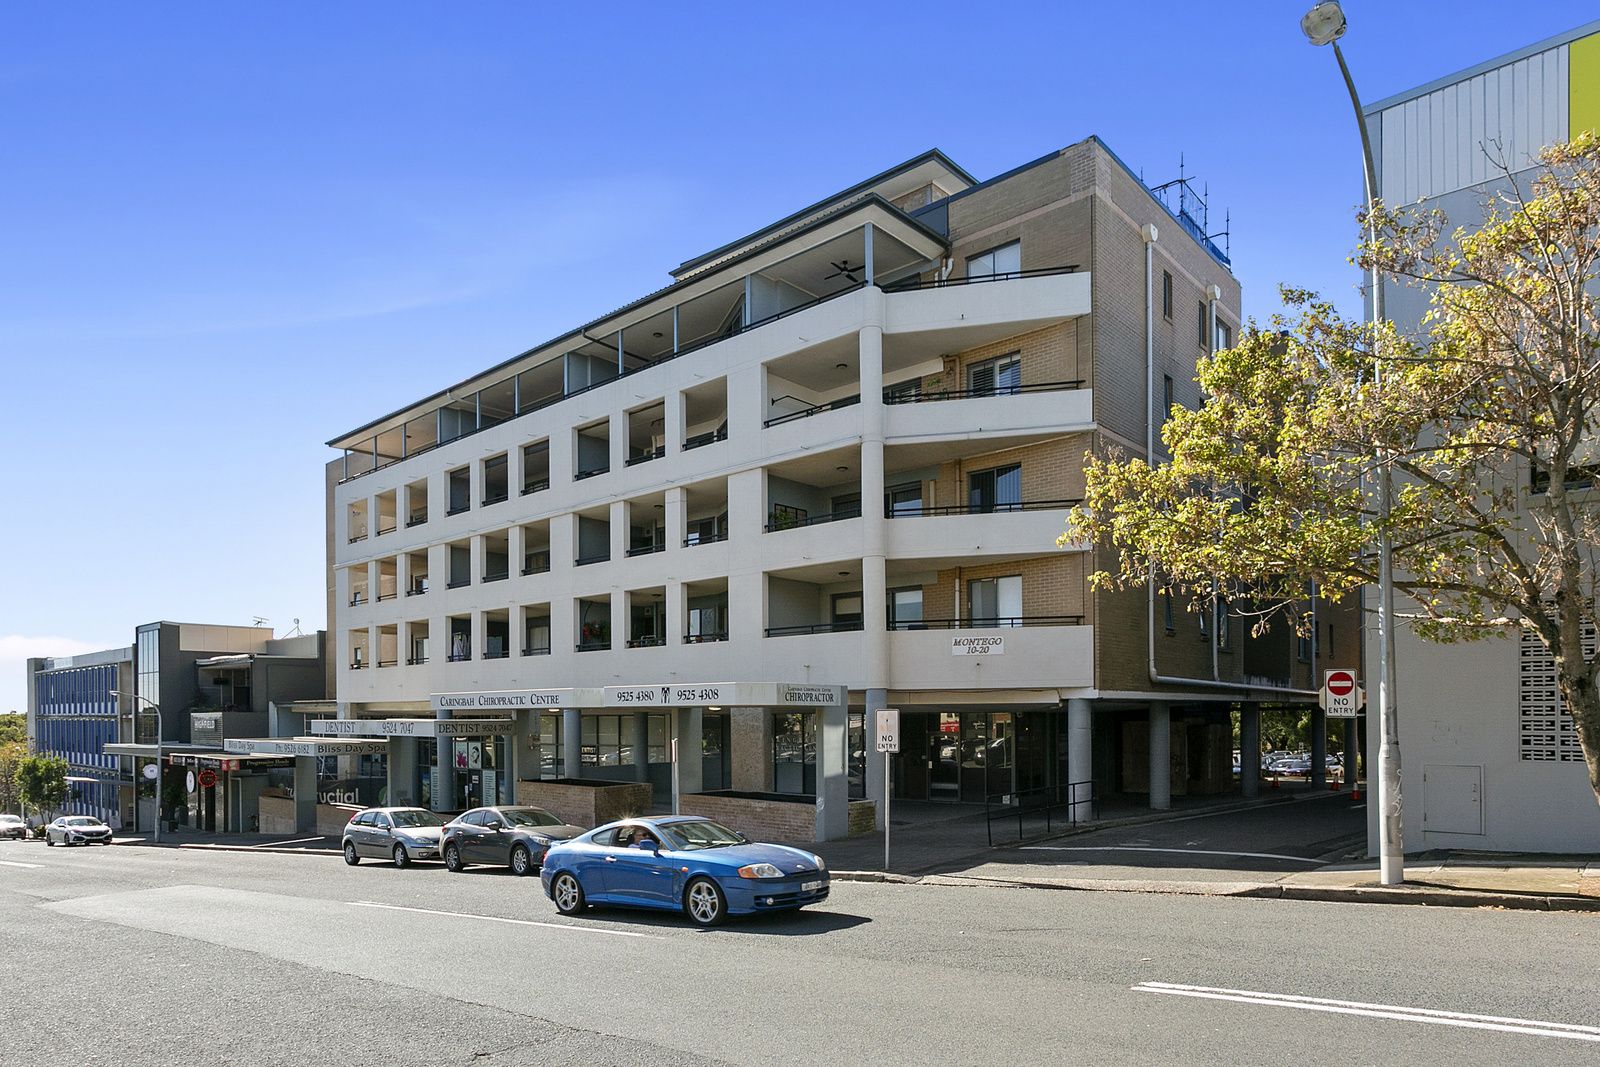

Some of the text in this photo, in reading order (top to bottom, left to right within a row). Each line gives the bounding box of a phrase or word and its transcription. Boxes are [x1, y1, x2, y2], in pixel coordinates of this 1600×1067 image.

[953, 637, 1002, 646] MONTEGO
[966, 646, 990, 654] 10-20
[617, 690, 654, 702] 9525 4380
[677, 688, 719, 700] 9525 4308
[785, 692, 834, 702] CHIROPRACTOR
[440, 694, 560, 706] CARINGBAH CHIROPRACTIC CENTRE
[325, 722, 414, 734] DENTIST 9524 7047
[438, 724, 480, 734] DENTIST
[318, 744, 386, 754] Bliss Day Spa
[317, 788, 359, 804] uctial
